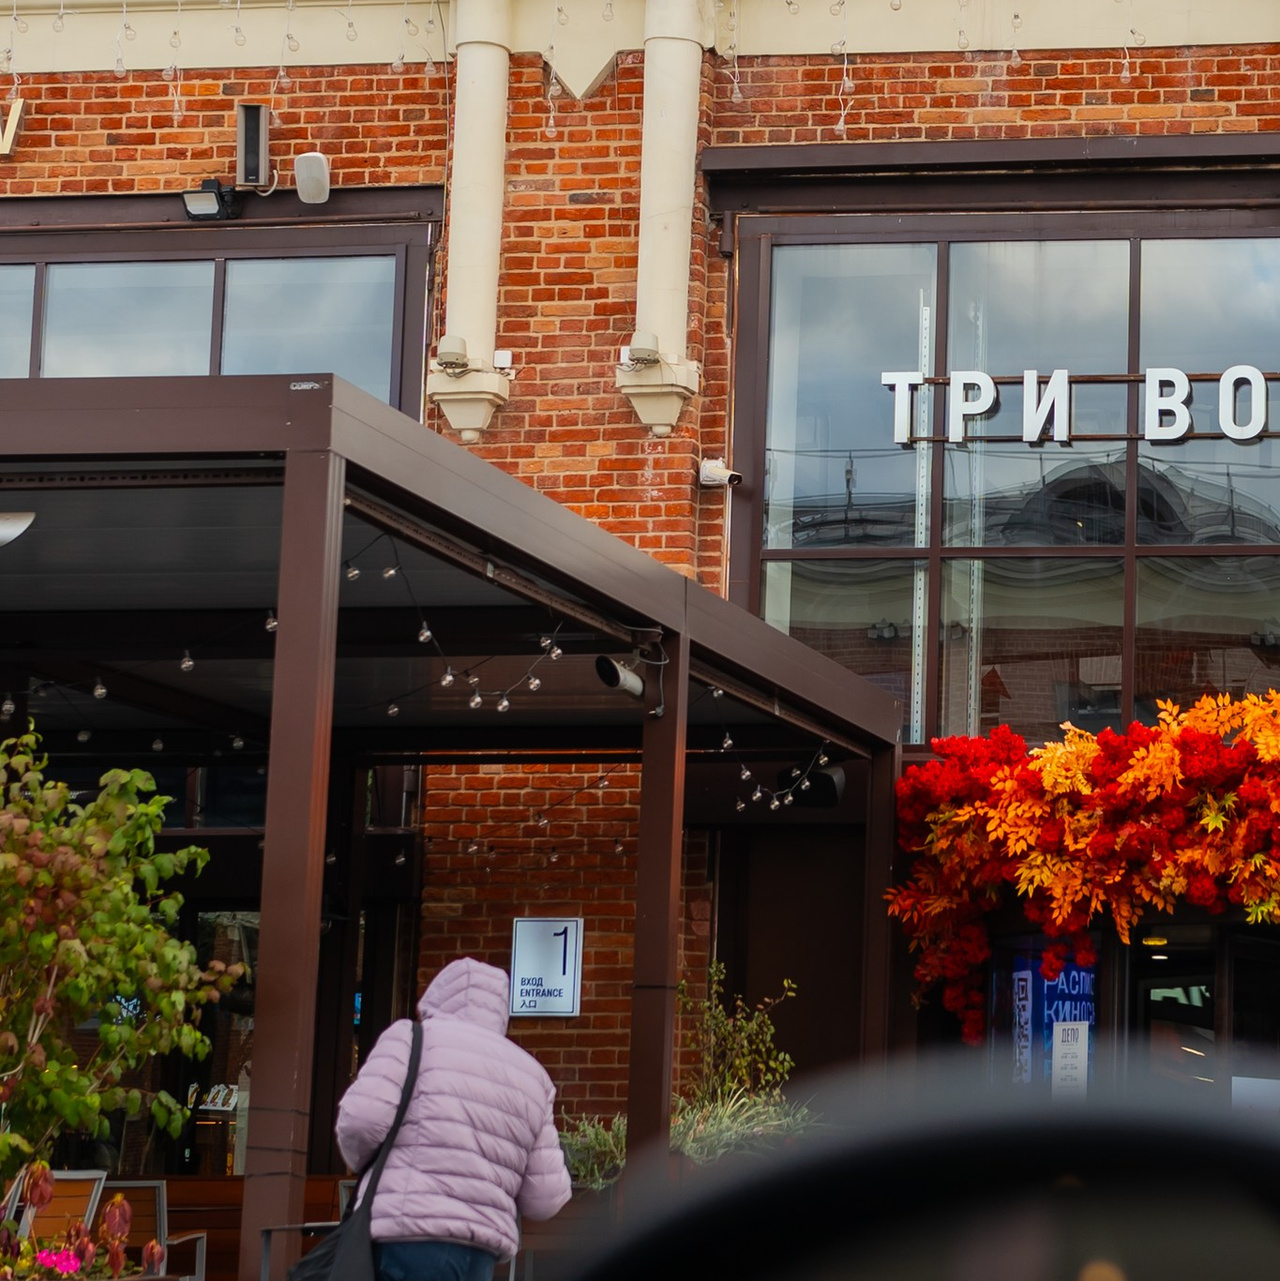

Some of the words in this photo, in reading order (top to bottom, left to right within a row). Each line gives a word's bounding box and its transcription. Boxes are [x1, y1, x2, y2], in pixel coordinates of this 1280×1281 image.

[881, 369, 1071, 445] ТРИ
[553, 926, 568, 976] 1
[520, 977, 544, 987] ВХОД
[520, 988, 563, 998] ENTRANCE
[520, 1000, 537, 1008] 入口
